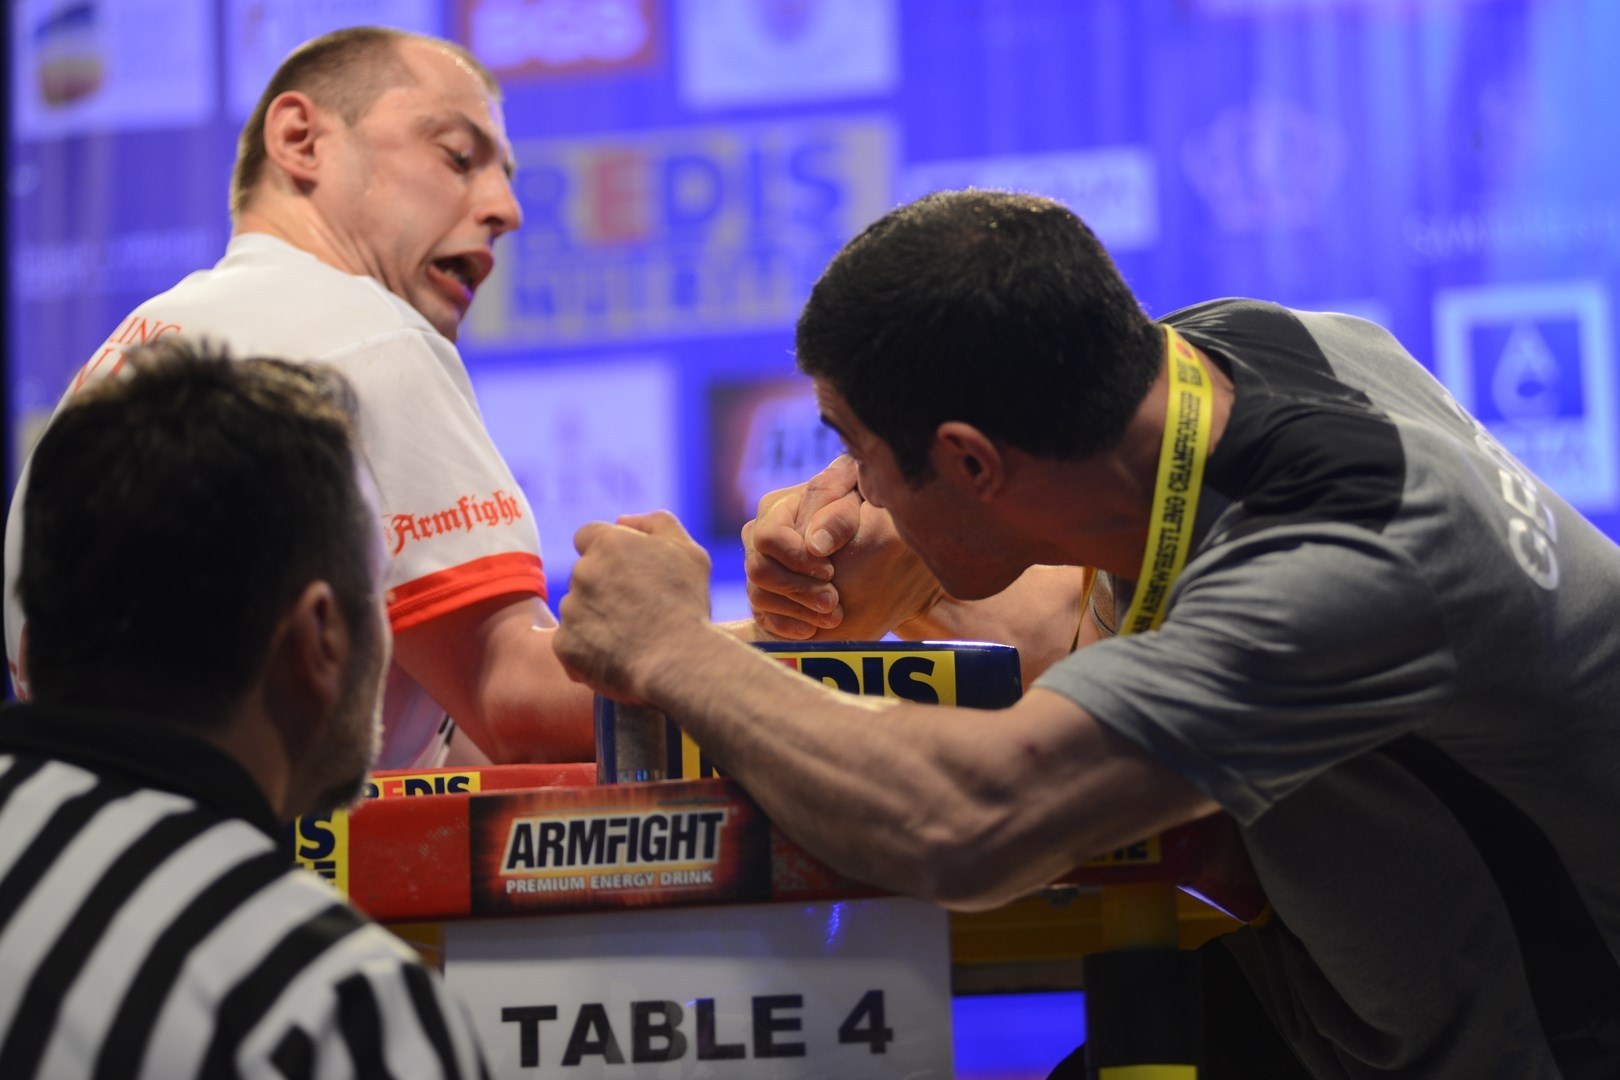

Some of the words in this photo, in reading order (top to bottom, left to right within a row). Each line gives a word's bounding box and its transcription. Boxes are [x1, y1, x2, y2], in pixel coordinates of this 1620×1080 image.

[515, 146, 844, 254] REDIS
[390, 490, 522, 556] Armfight
[776, 656, 939, 707] DIS
[505, 811, 725, 870] ARMFIGHT
[505, 876, 585, 894] PREMIUM
[590, 873, 656, 889] ENERGY
[660, 869, 714, 886] DRINK
[501, 994, 806, 1068] TABLE
[838, 989, 894, 1054] 4
